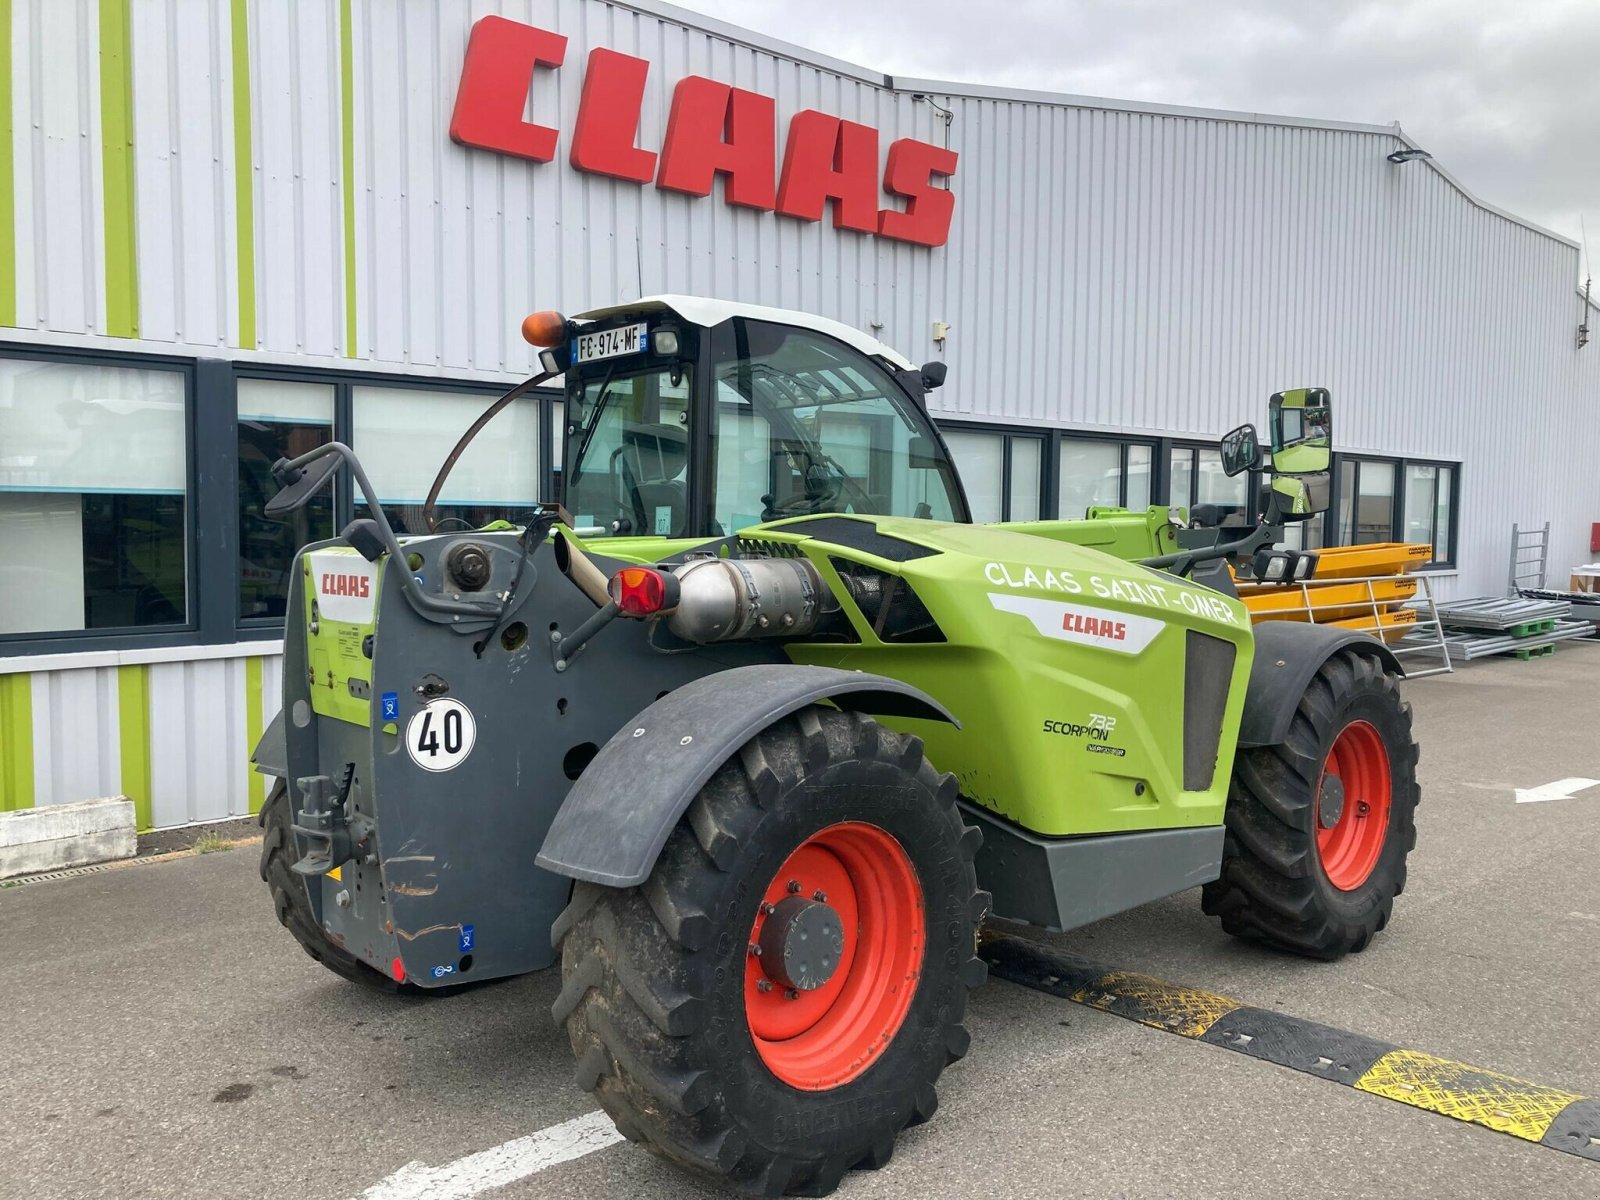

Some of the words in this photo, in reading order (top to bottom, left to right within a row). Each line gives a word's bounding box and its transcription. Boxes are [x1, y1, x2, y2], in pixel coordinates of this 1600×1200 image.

[449, 15, 959, 248] CLAAS
[322, 573, 369, 598] CLAAS
[984, 562, 1082, 594] CLAAS
[1089, 575, 1240, 625] SAINT-OMER
[1062, 613, 1126, 641] CLAAS
[418, 709, 462, 757] 40
[1043, 720, 1109, 741] SCORPION
[1087, 713, 1117, 731] 732
